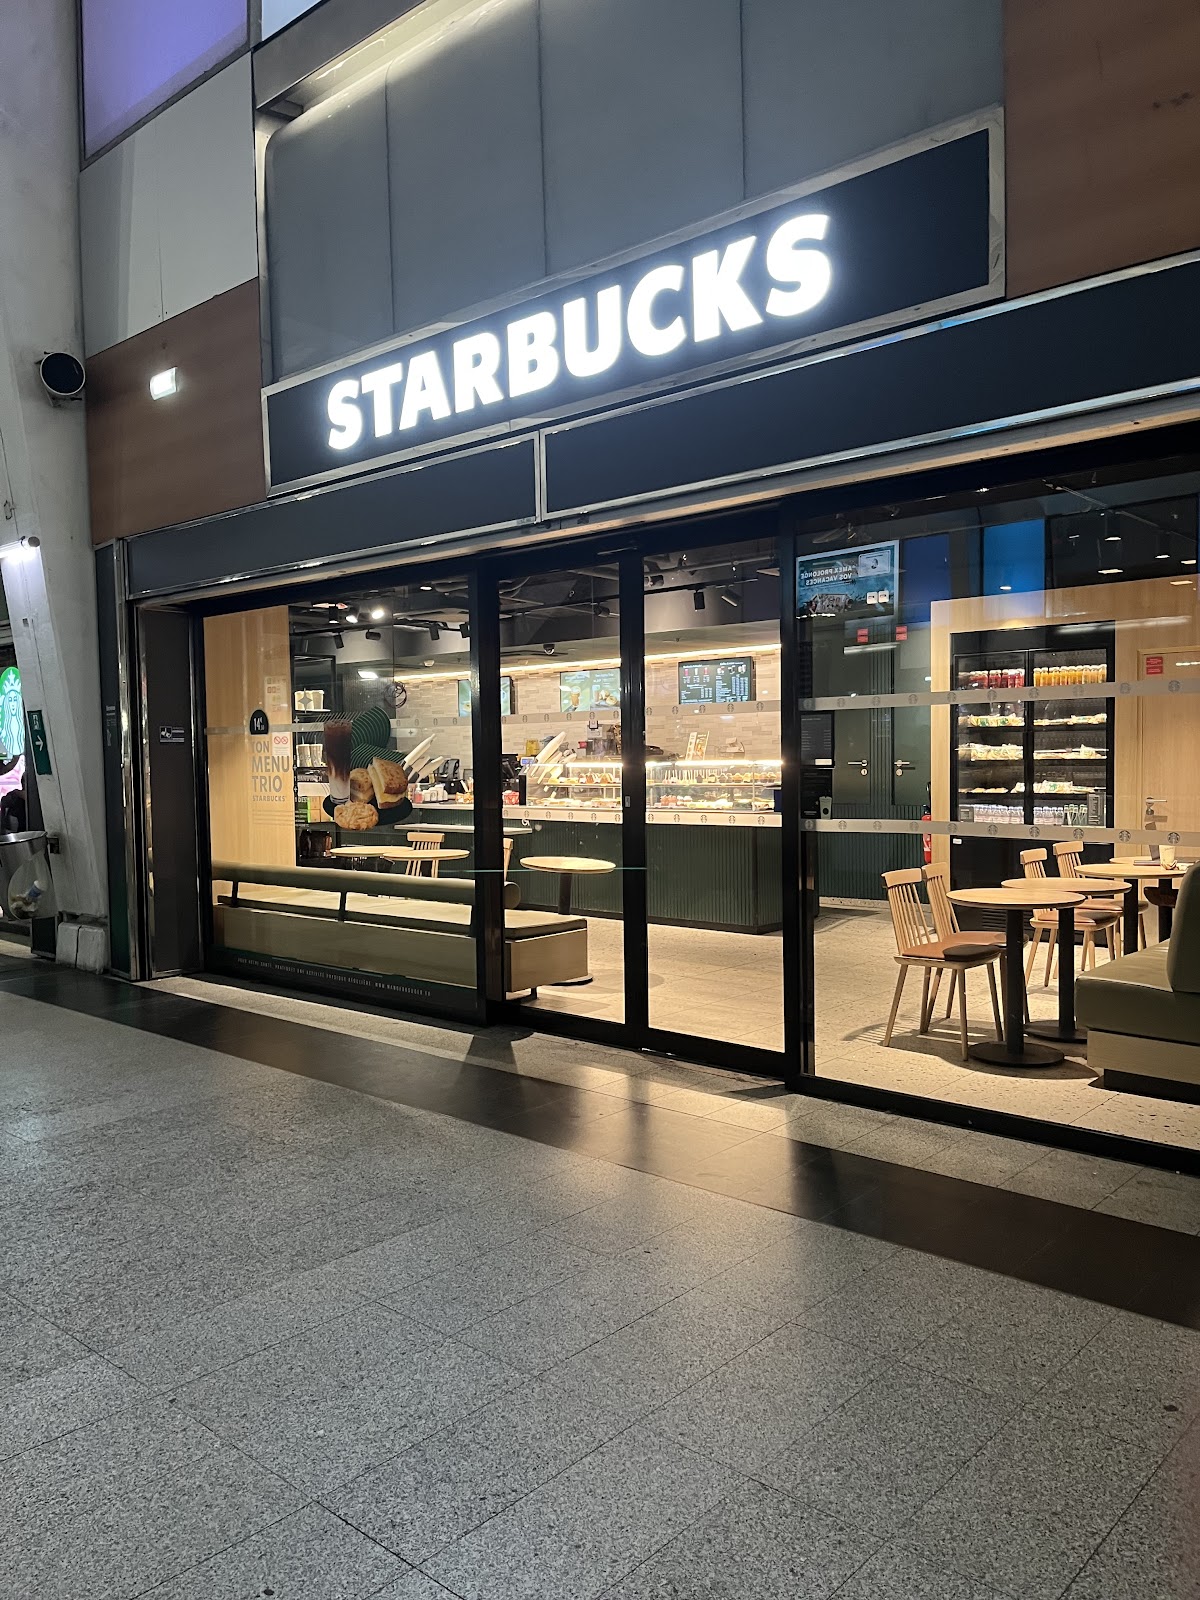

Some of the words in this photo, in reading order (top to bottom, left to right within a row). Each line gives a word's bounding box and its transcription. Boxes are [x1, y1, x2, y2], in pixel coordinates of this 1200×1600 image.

[327, 213, 832, 451] STARBUCKS
[251, 755, 290, 773] MENU
[251, 775, 283, 793] TRIO
